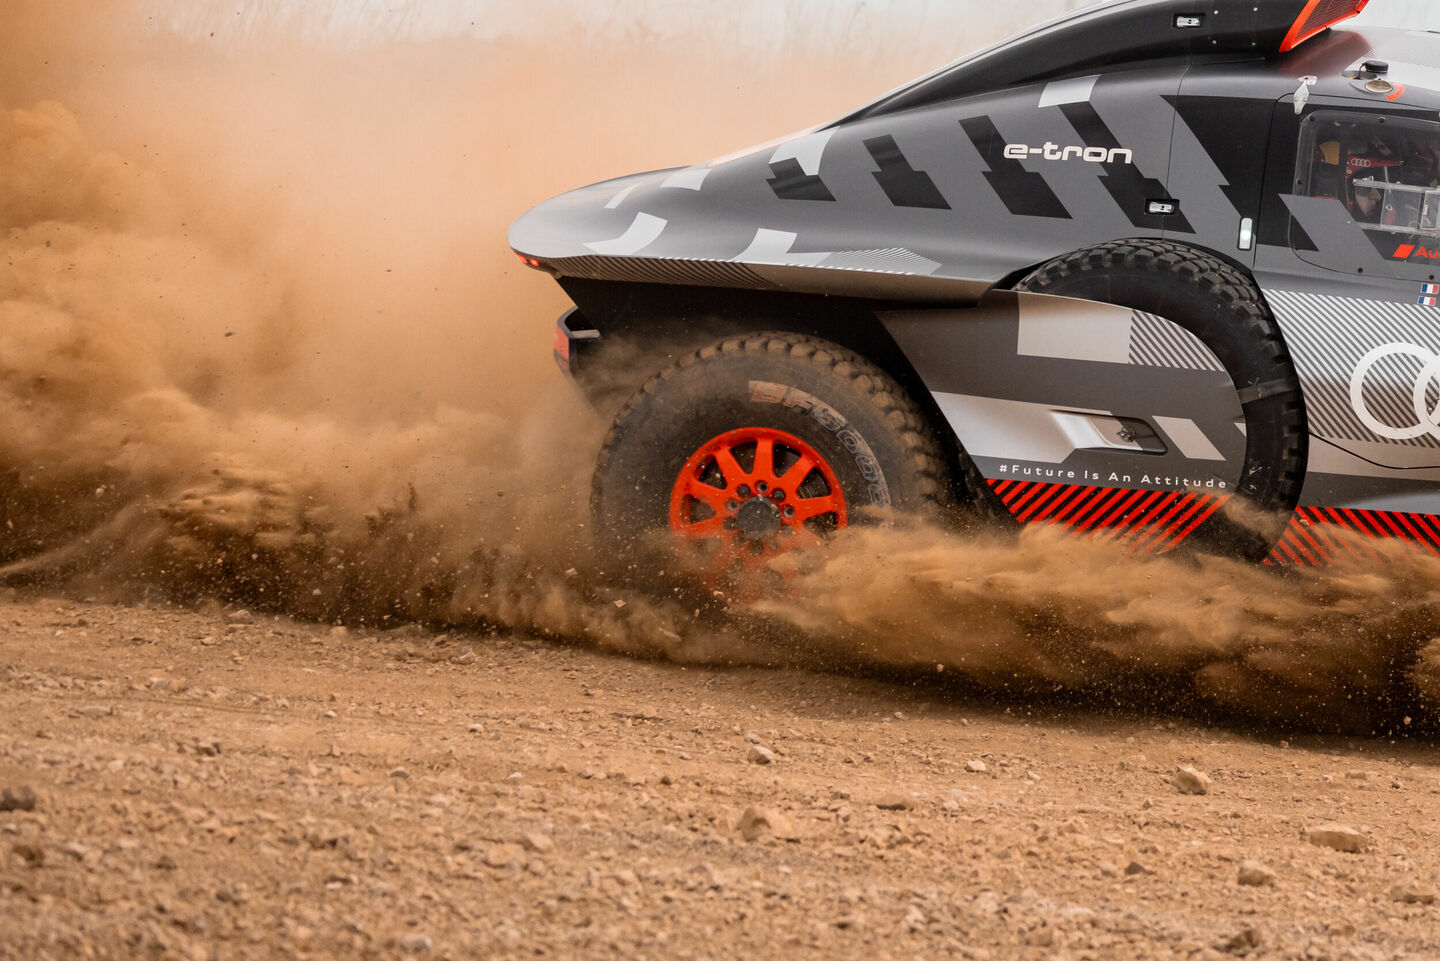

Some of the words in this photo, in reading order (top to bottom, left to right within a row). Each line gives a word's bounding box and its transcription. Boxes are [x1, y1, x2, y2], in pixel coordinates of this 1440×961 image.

[1003, 141, 1133, 165] e-tron
[999, 464, 1075, 478] #Future
[1084, 469, 1099, 480] Is
[1108, 472, 1131, 482] An
[1140, 474, 1227, 489] Attitude
